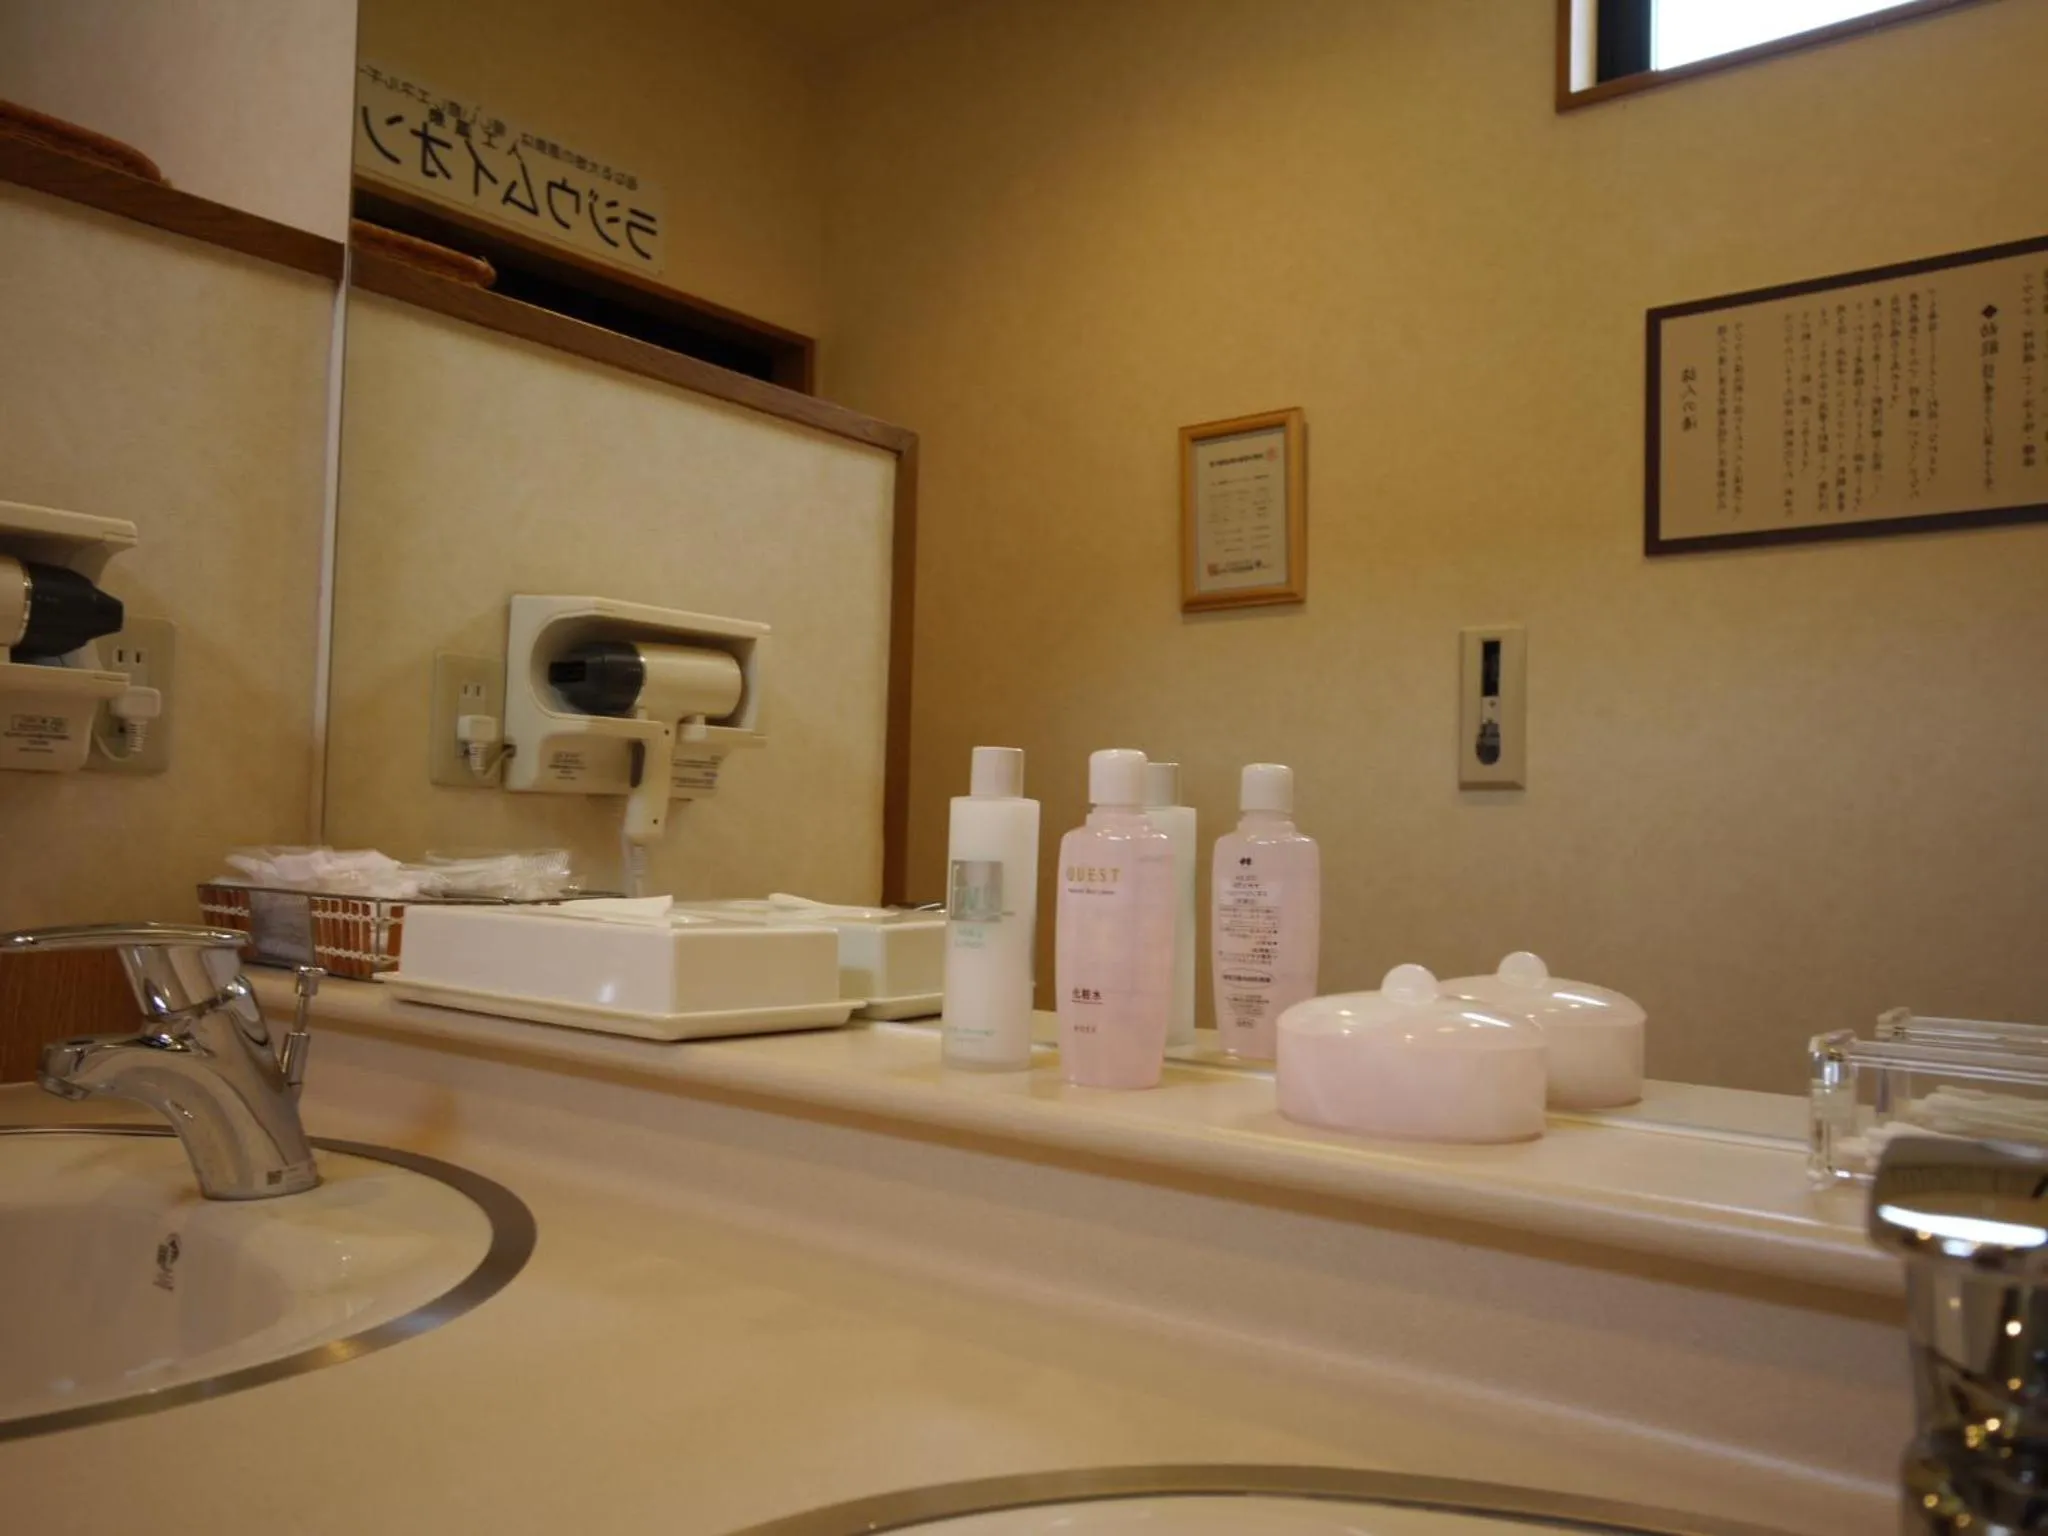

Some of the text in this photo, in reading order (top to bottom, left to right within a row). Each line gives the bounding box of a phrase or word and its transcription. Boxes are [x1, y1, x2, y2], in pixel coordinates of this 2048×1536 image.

[1066, 866, 1120, 882] QUEST
[1072, 987, 1102, 1001] 化粧水
